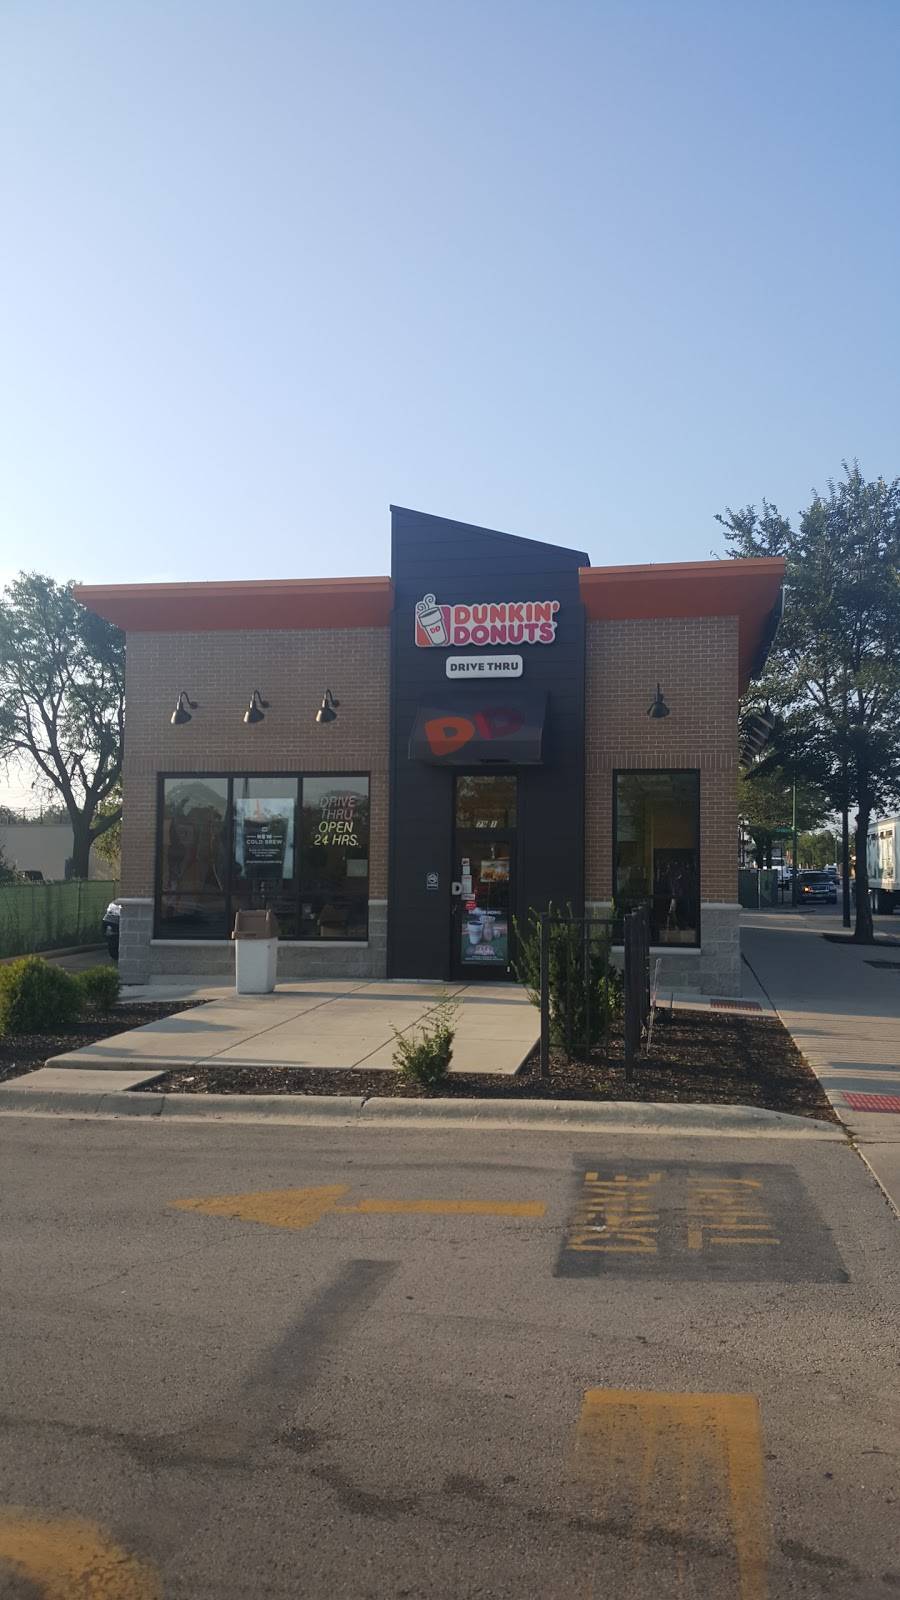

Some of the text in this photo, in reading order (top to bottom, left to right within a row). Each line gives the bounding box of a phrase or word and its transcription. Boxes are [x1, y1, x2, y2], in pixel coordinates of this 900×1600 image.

[454, 602, 560, 625] DUNKIN'
[454, 623, 555, 645] DONUTS
[450, 661, 519, 672] DRIVE THRU
[425, 707, 525, 756] DD
[319, 795, 357, 808] DRIVE
[321, 808, 354, 820] THRU
[318, 821, 354, 833] OPEN
[313, 834, 360, 846] 24 HRS.
[566, 1171, 664, 1253] DRIVE
